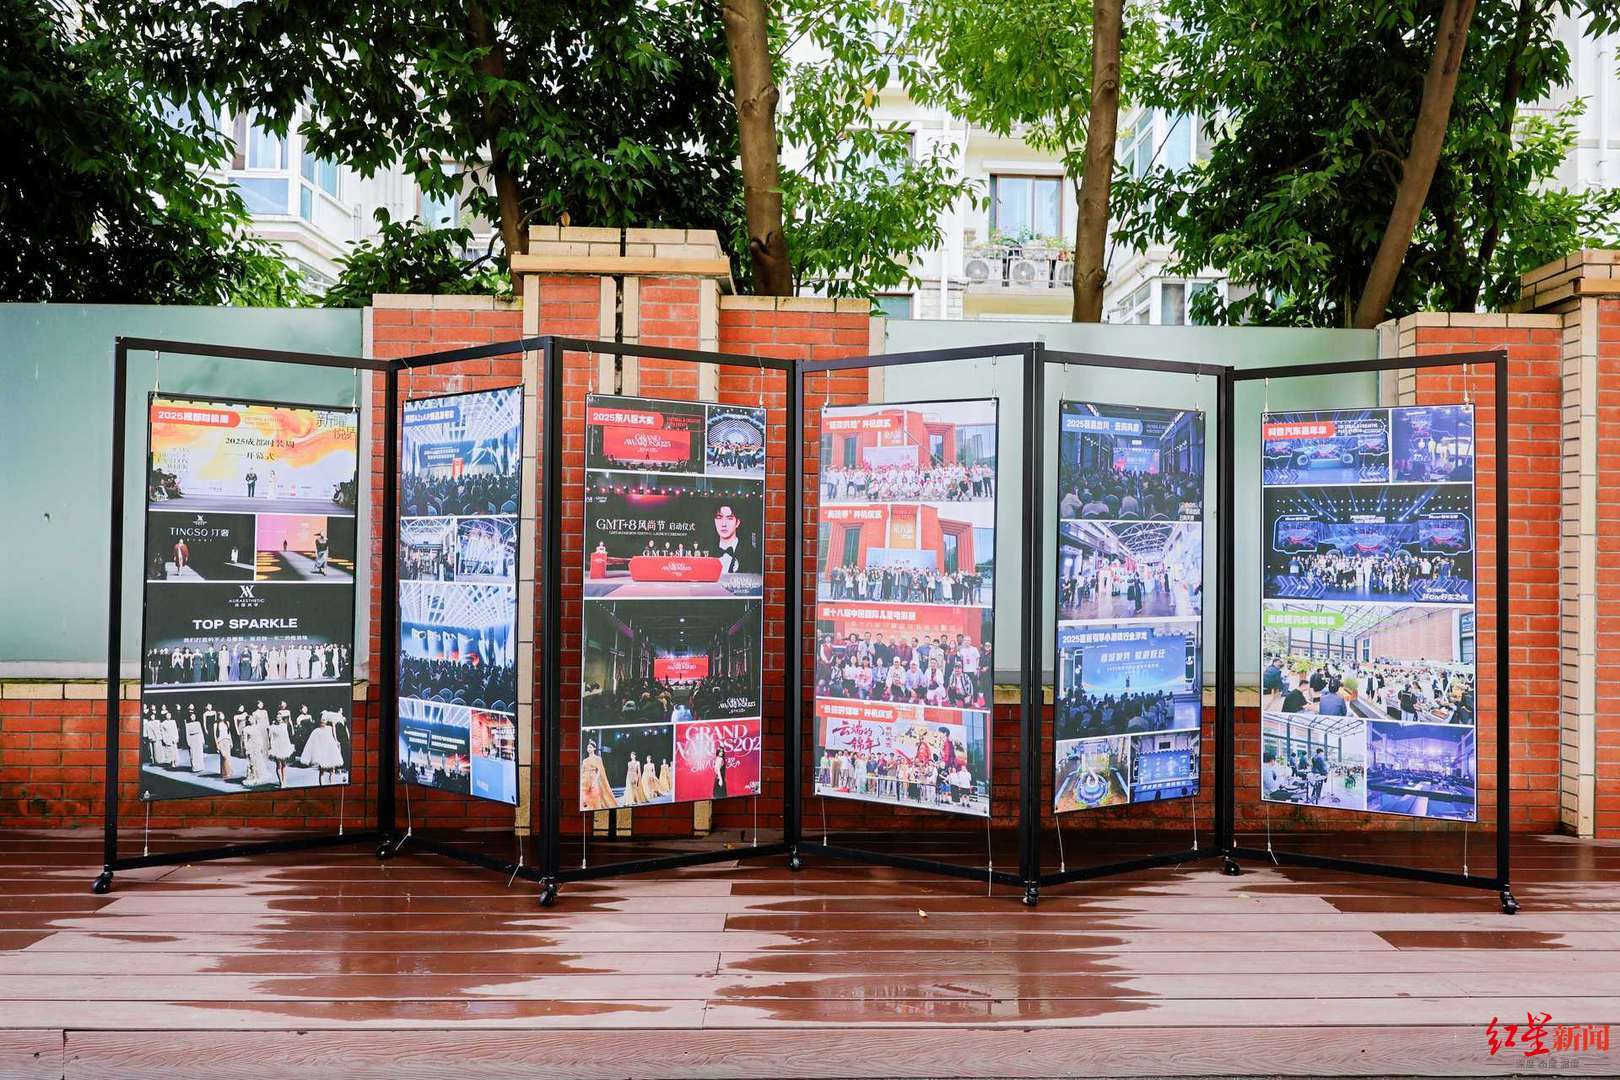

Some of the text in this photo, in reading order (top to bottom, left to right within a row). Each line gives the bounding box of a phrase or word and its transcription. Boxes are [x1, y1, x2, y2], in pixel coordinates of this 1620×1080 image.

[595, 517, 696, 532] GMT+8风尚节 启动仪式
[170, 527, 208, 537] TINGSO
[192, 617, 298, 630] TOP SPARKLE
[686, 724, 748, 740] GRAND
